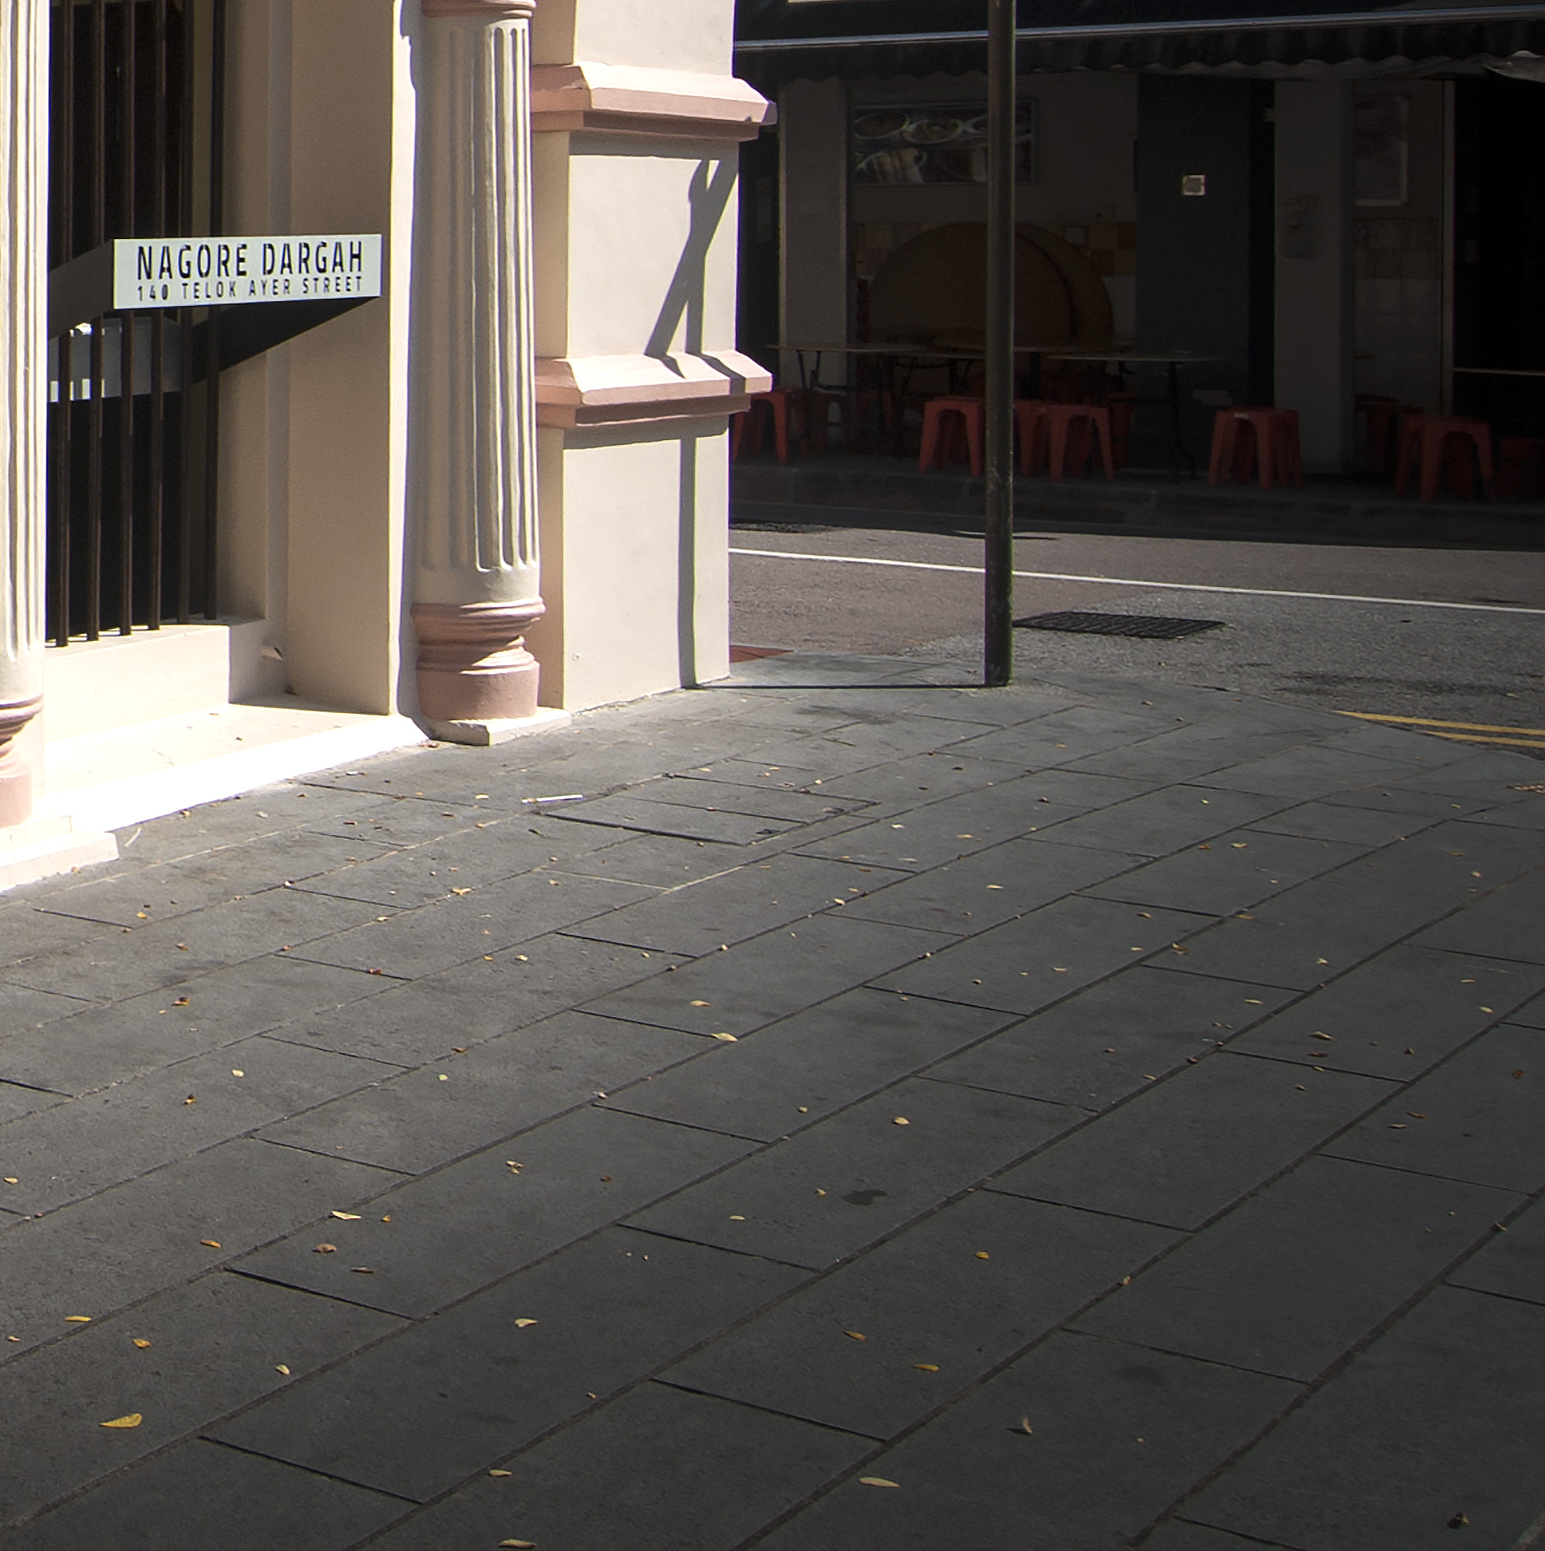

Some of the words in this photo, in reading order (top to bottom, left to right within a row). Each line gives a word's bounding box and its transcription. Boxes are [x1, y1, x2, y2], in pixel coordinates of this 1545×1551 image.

[137, 244, 248, 280] NAGORE
[262, 241, 363, 275] DARGAH
[138, 284, 169, 301] 140
[182, 280, 237, 299] TELOK
[248, 279, 291, 296] AYER
[303, 276, 363, 293] STREET
